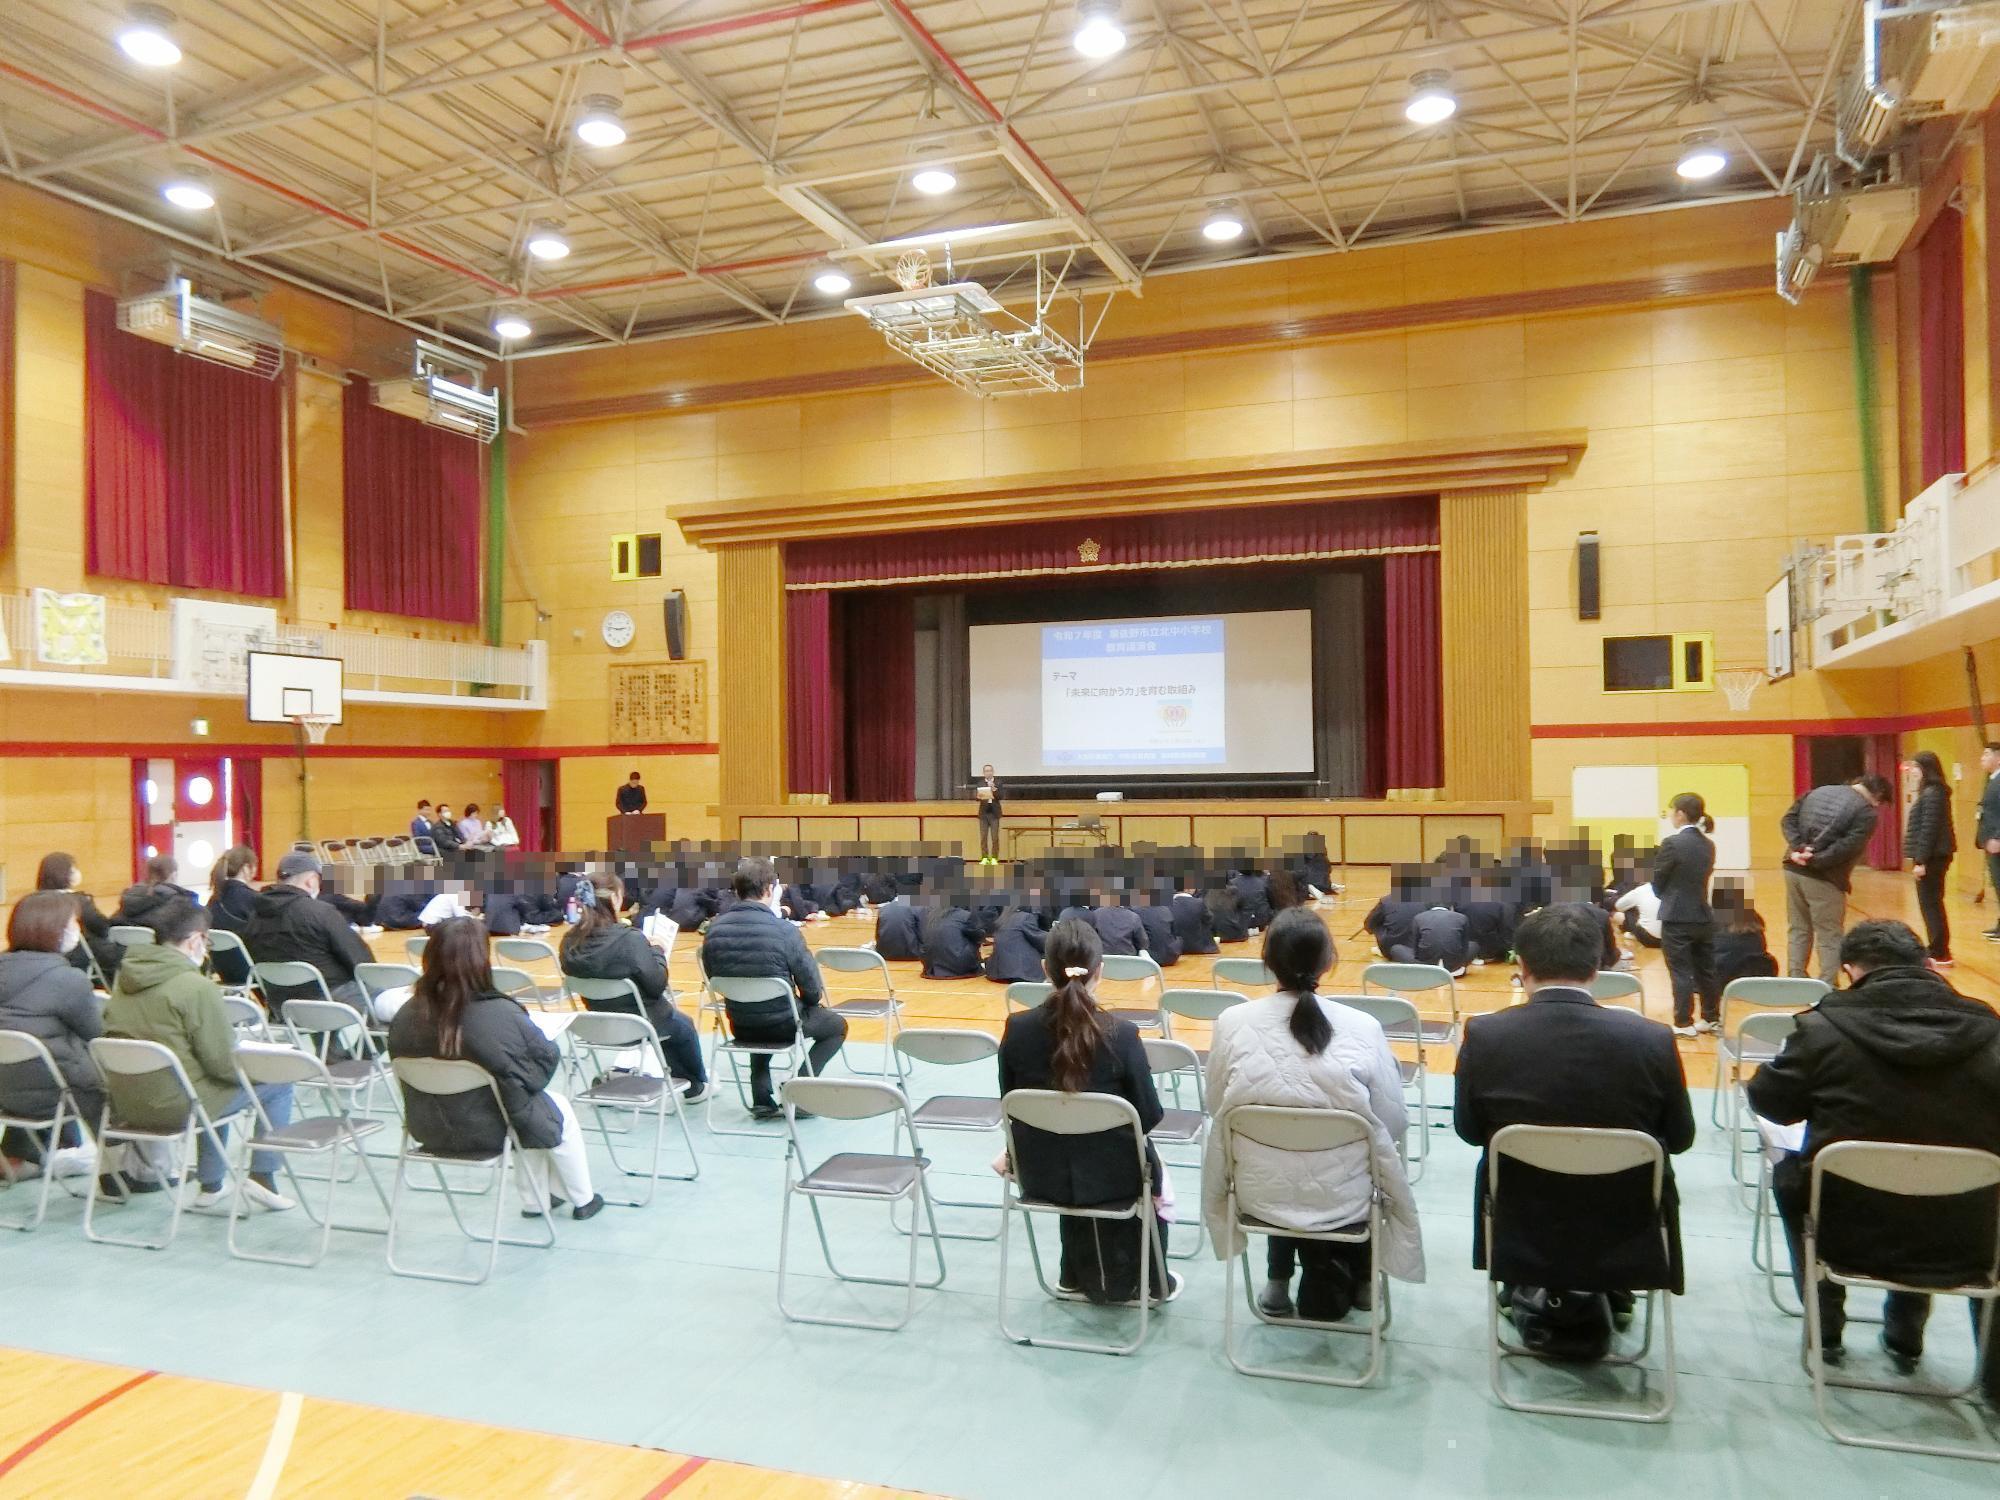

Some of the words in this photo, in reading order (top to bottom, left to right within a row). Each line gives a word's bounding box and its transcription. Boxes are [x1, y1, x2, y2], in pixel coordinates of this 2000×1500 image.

[1053, 671, 1078, 682] テーマ
[1066, 684, 1196, 697] 「未来に向かう力」を育む取組み
